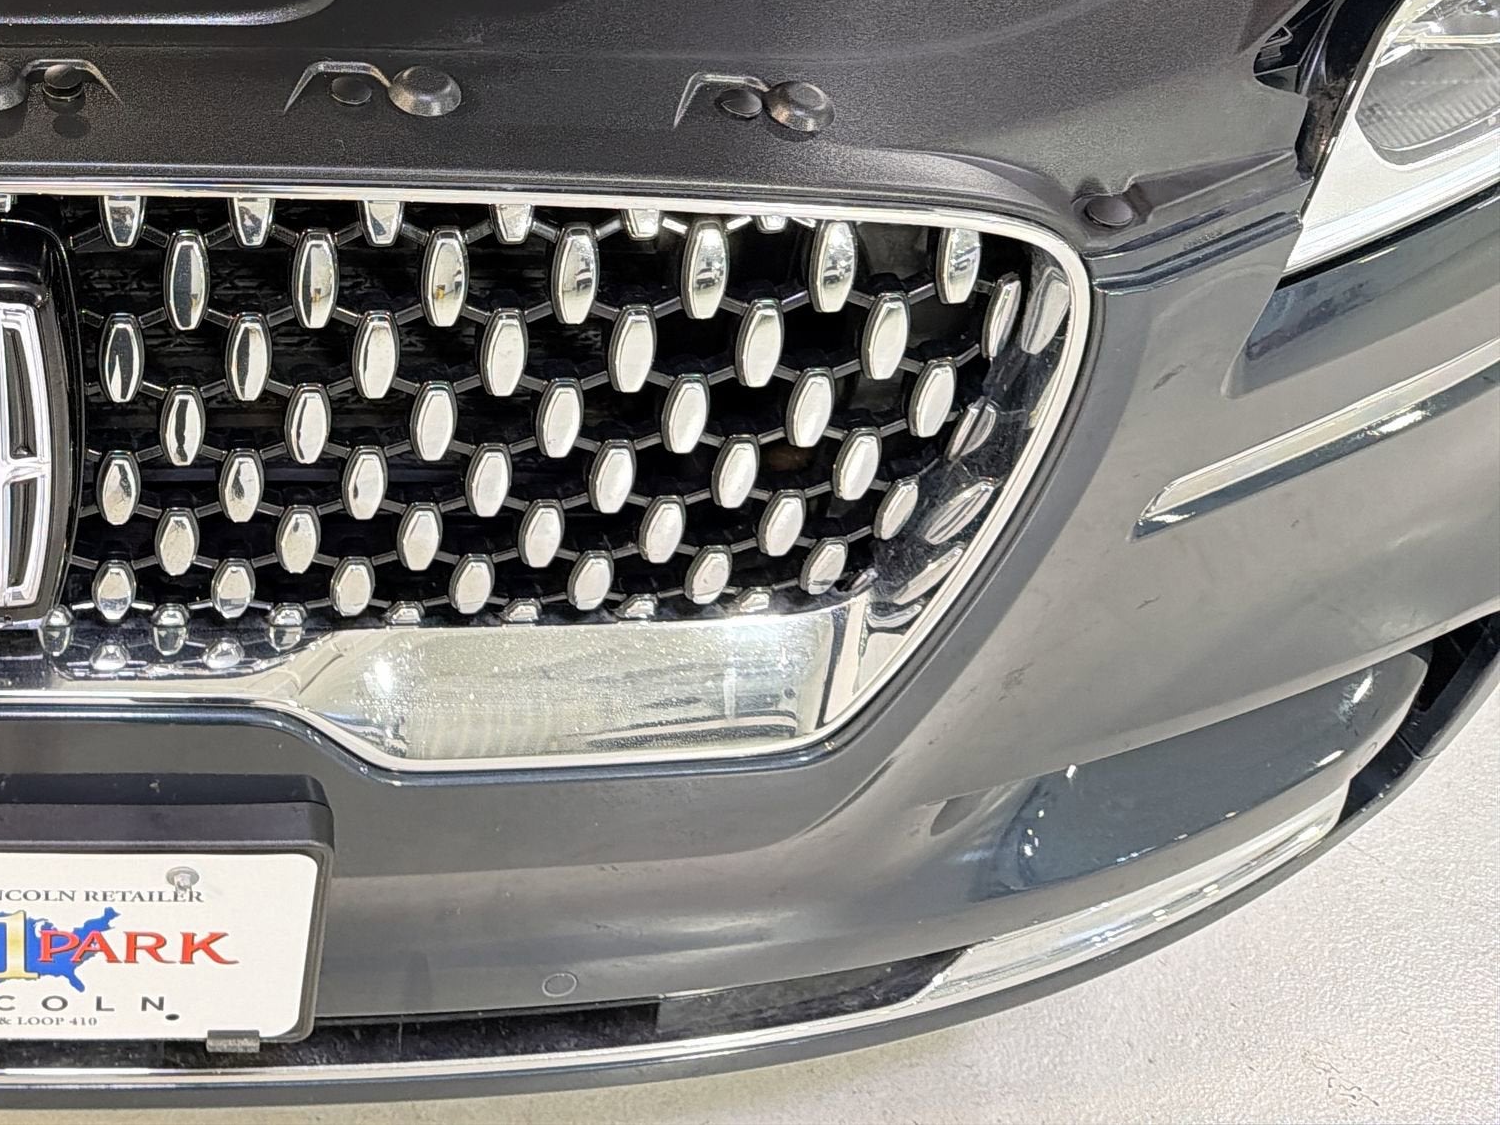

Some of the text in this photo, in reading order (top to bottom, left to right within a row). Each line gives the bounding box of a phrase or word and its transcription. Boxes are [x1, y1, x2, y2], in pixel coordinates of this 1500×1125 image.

[84, 889, 204, 903] RETAILER
[38, 930, 241, 965] PARK
[18, 1016, 65, 1026] LOOP
[68, 1017, 98, 1026] 410
